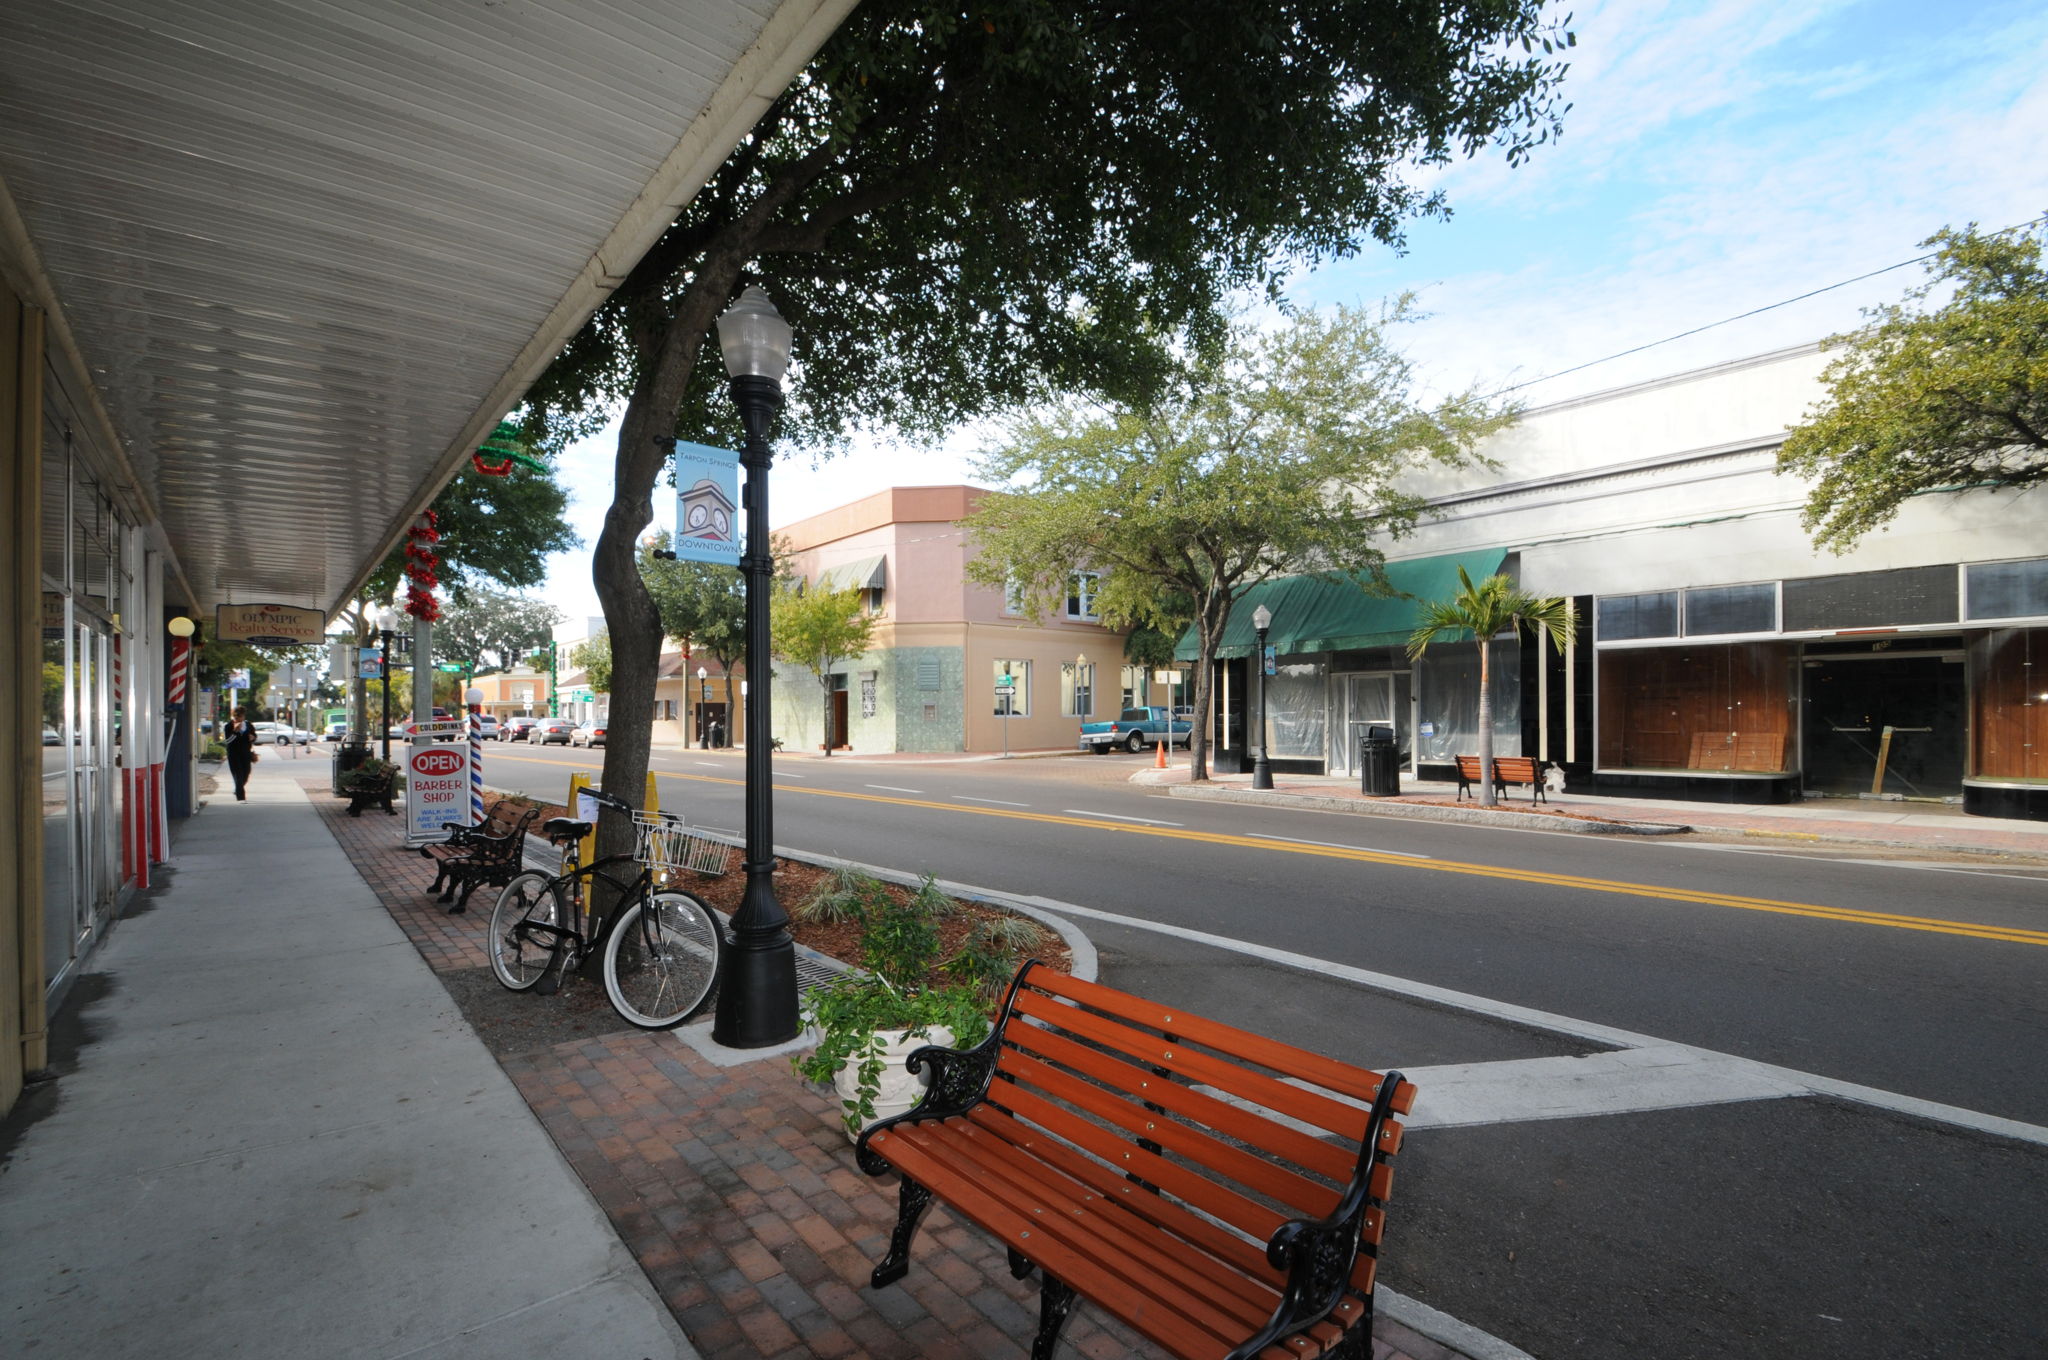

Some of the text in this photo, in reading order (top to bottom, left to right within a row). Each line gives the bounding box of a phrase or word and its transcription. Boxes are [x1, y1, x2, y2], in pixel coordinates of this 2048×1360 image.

[680, 452, 737, 470] TARPON SPRINGS
[678, 539, 738, 553] DOWNTOWN
[242, 612, 302, 625] OLYMPIC
[229, 621, 316, 636] Realty Services
[419, 721, 464, 732] COLD DRINKS
[416, 755, 460, 771] OPEN
[414, 780, 463, 792] BARBER
[423, 792, 455, 804] SHOP
